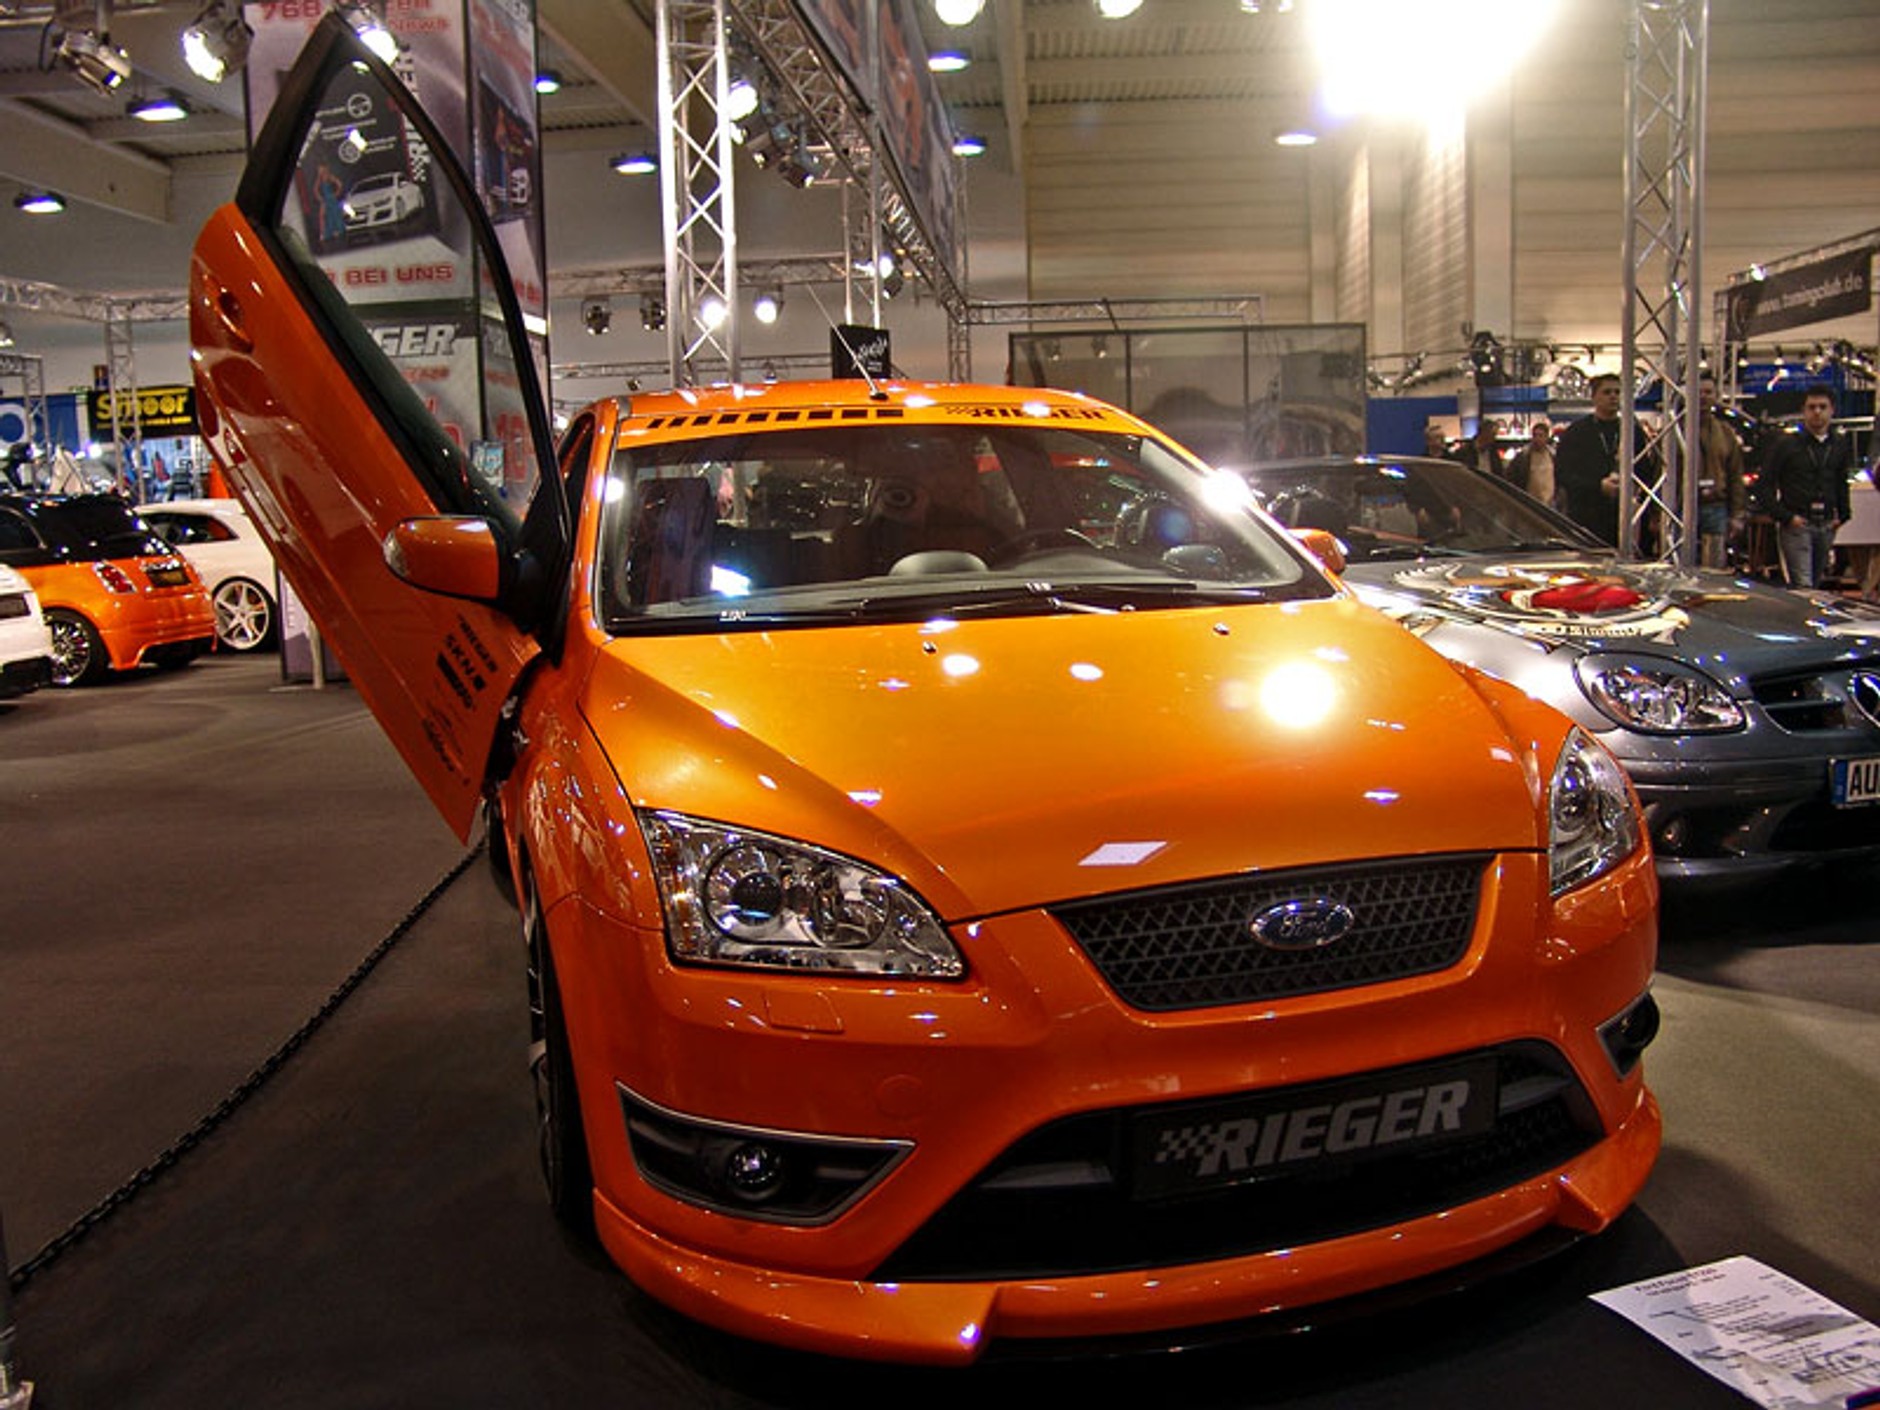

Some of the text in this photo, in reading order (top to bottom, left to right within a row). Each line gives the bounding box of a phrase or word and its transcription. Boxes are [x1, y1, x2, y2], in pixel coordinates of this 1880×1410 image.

[345, 266, 388, 286] BEI
[396, 264, 454, 283] UNS
[368, 323, 456, 357] GER
[1196, 1080, 1470, 1177] RIEGER
